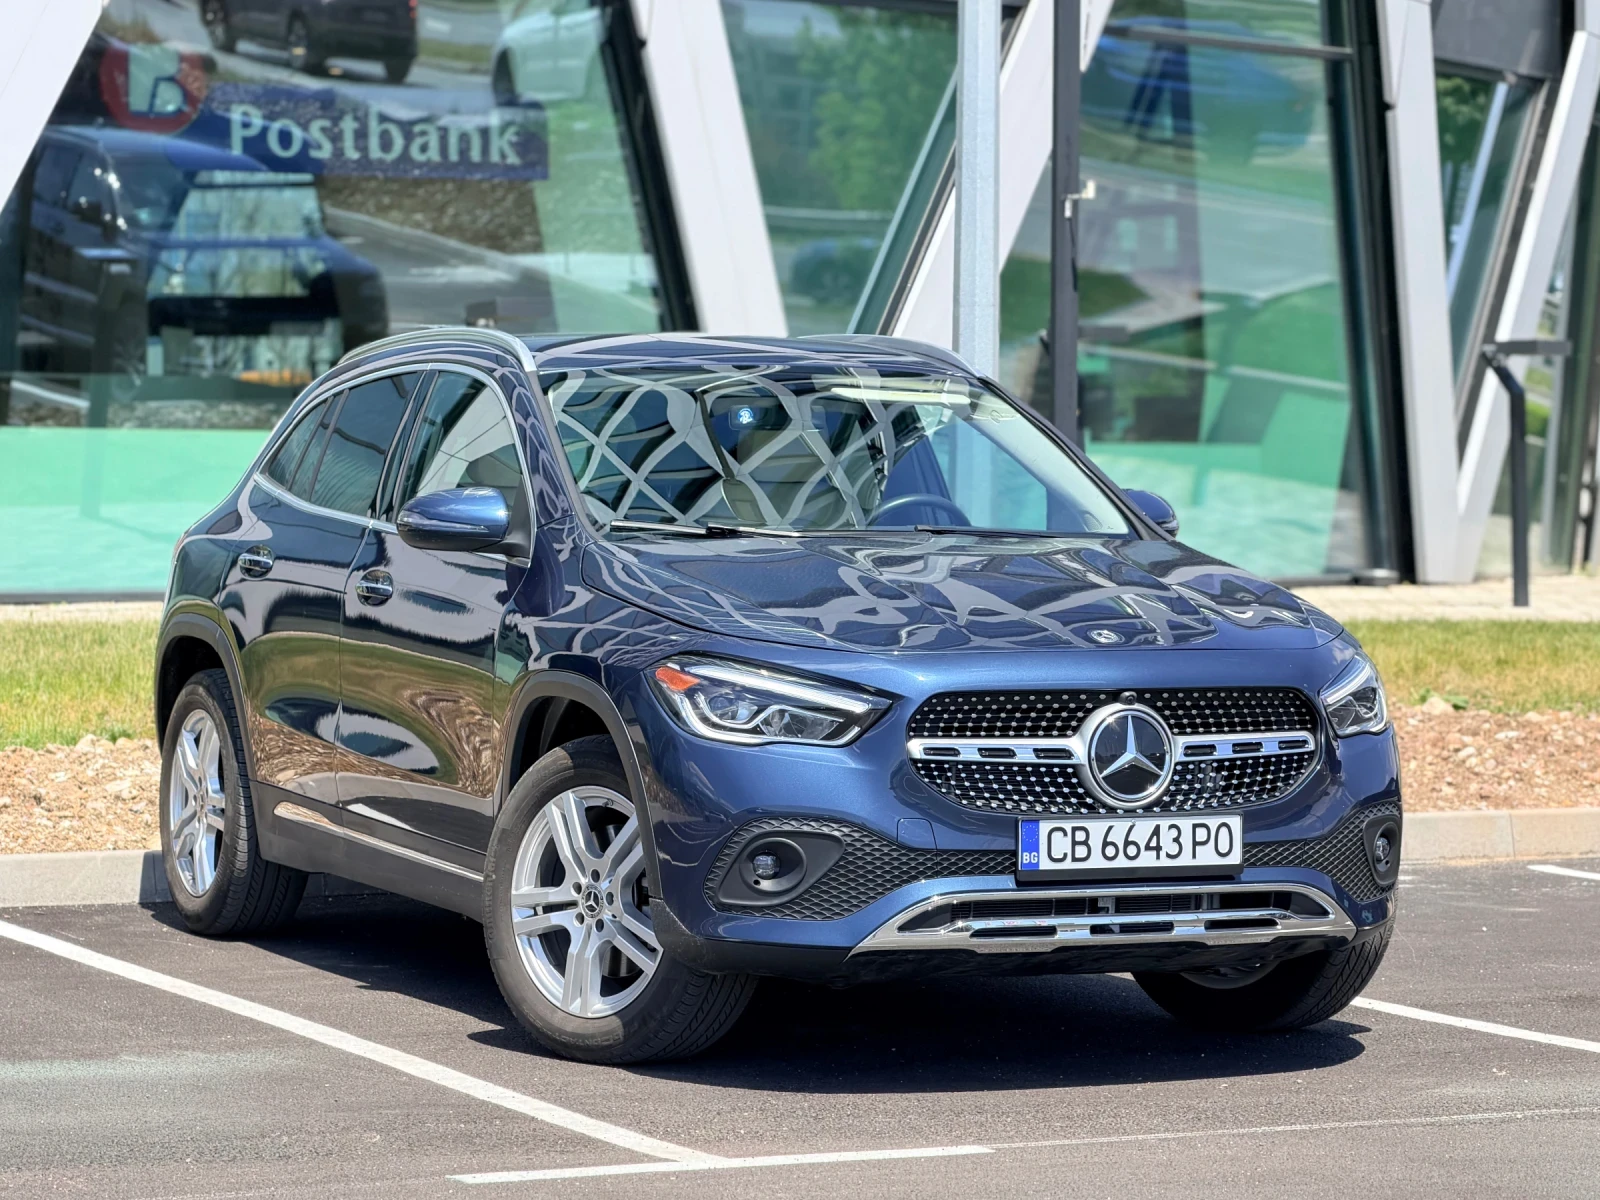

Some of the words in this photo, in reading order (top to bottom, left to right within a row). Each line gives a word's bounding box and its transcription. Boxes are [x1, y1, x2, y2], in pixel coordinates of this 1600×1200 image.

[230, 103, 521, 164] Postbank
[1023, 852, 1038, 864] BG
[1047, 825, 1092, 863] CB
[1101, 823, 1183, 862] 6643
[1191, 821, 1234, 860] PO
